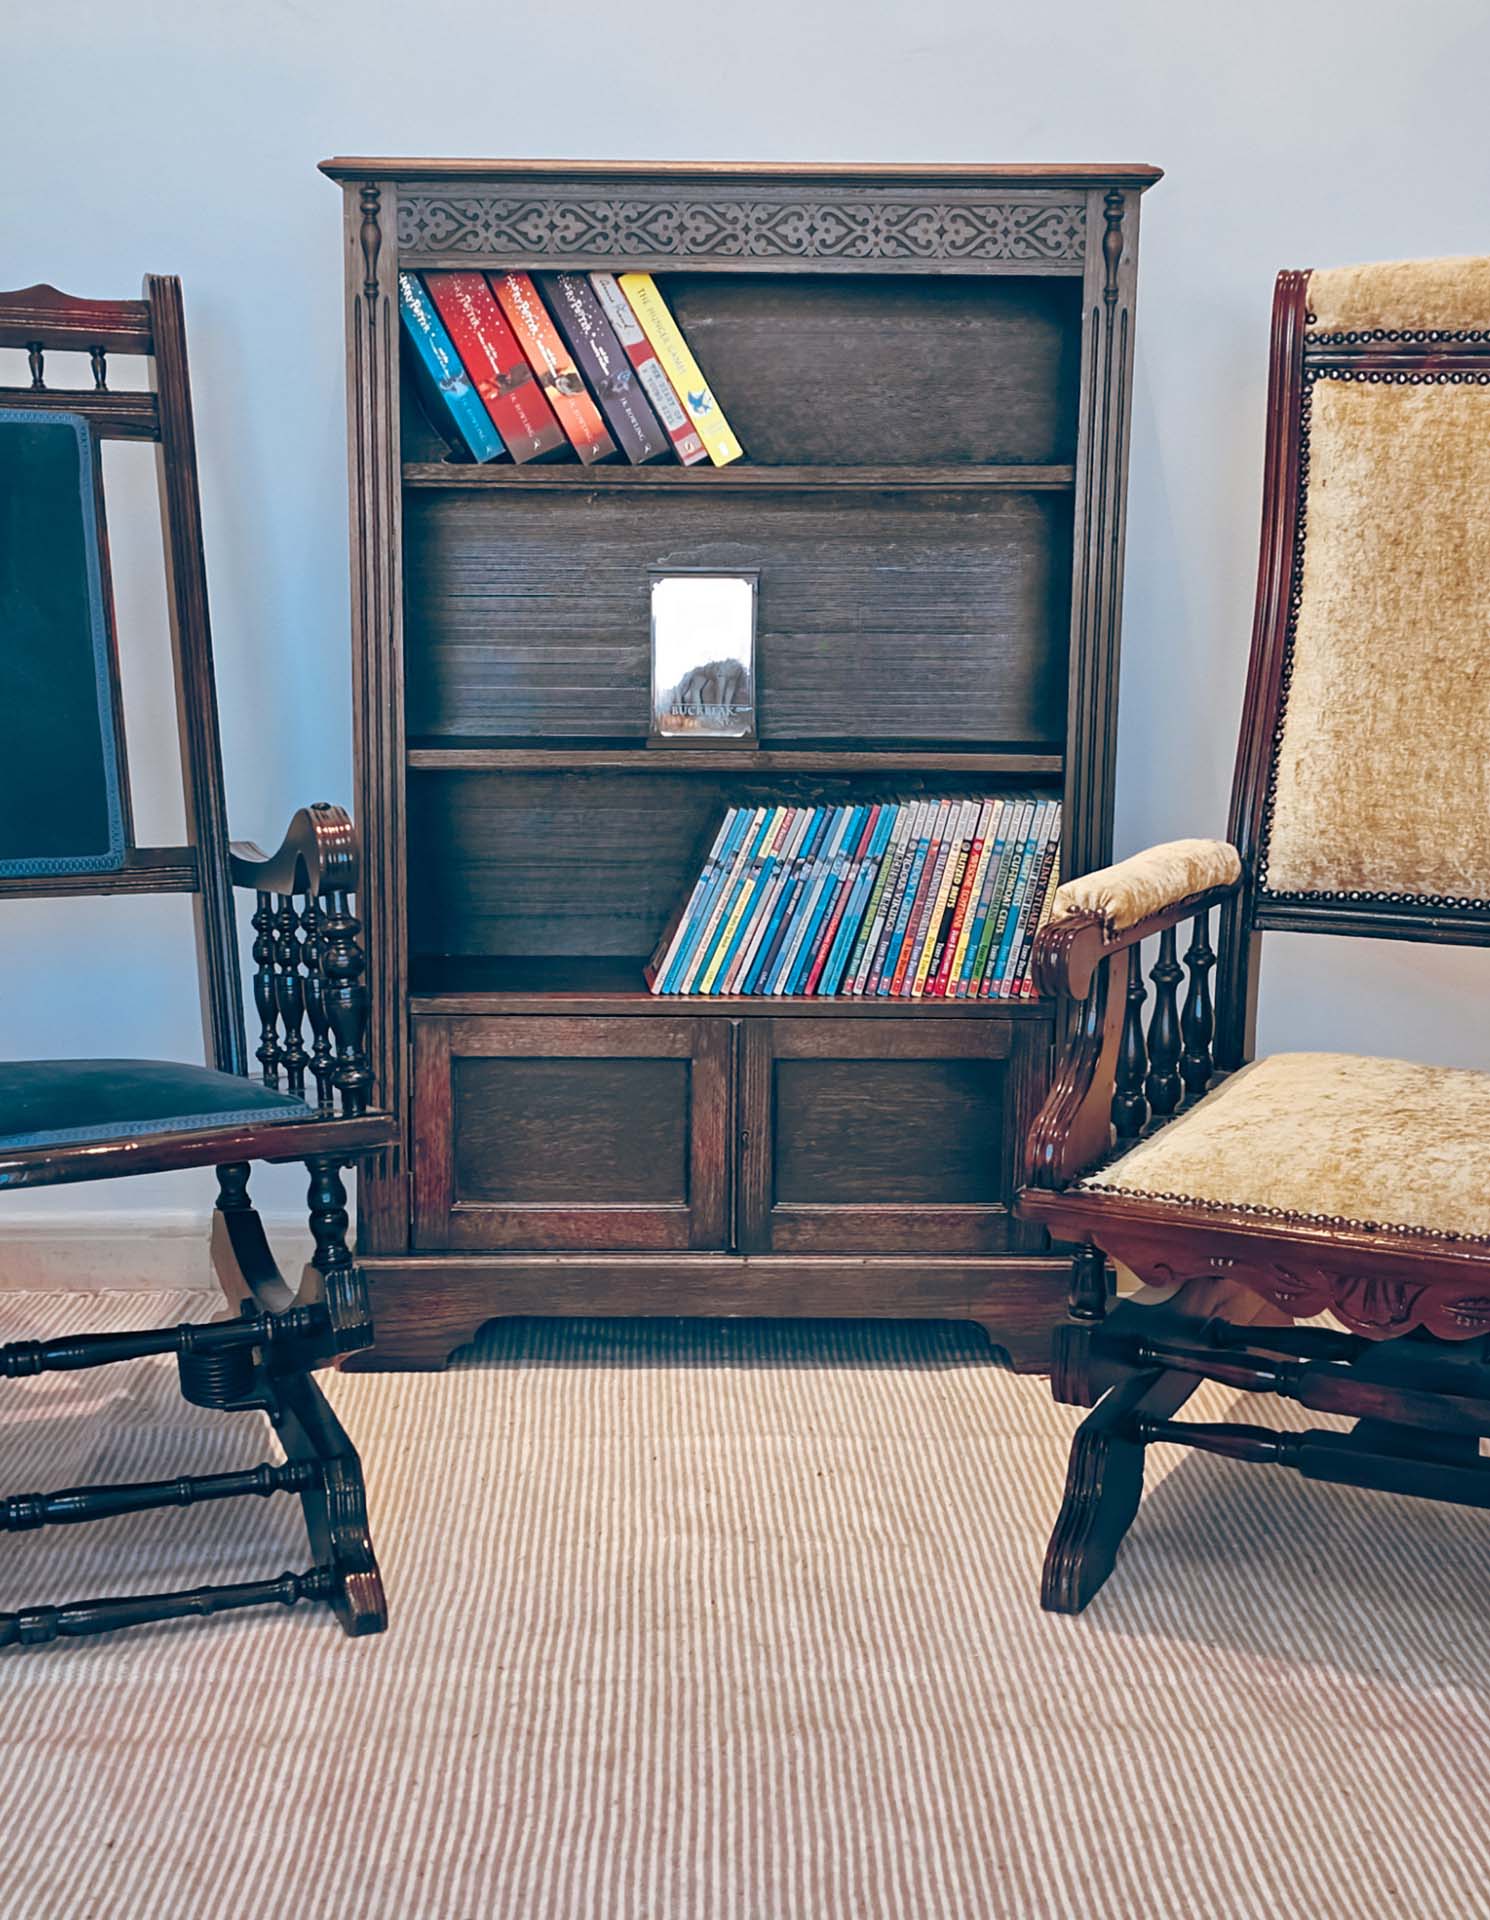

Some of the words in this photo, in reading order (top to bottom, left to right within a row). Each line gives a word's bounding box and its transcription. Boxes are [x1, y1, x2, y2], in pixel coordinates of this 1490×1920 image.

[636, 287, 651, 306] THE
[624, 407, 645, 441] ROWLING
[895, 851, 914, 891] VICIOUS
[952, 851, 967, 884] BLITZED
[1036, 853, 1052, 888] SLIMY
[883, 891, 902, 932] VIKINGS
[946, 885, 958, 908] BRITS
[1024, 888, 1044, 936] STUARTS
[995, 908, 1008, 934] CELTS
